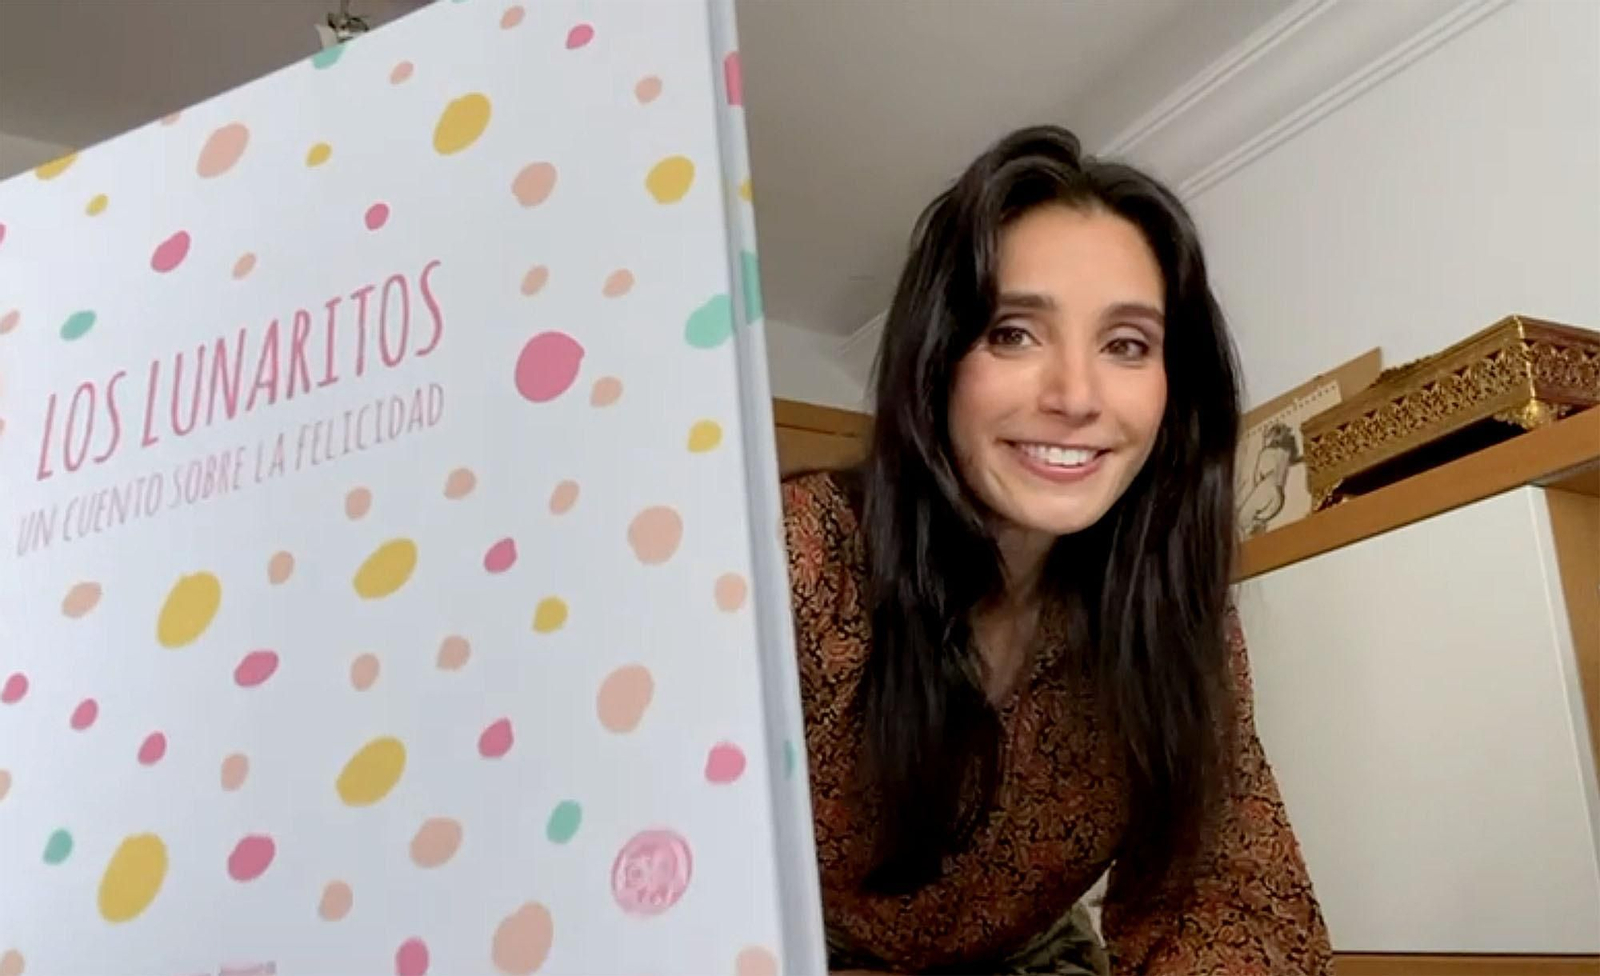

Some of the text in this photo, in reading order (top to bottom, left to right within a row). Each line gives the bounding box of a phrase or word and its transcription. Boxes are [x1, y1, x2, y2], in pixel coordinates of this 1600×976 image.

[37, 259, 443, 481] LOS LUNARITOS
[17, 382, 444, 557] UN CUENTO SOBRE LA FELICIDAD
